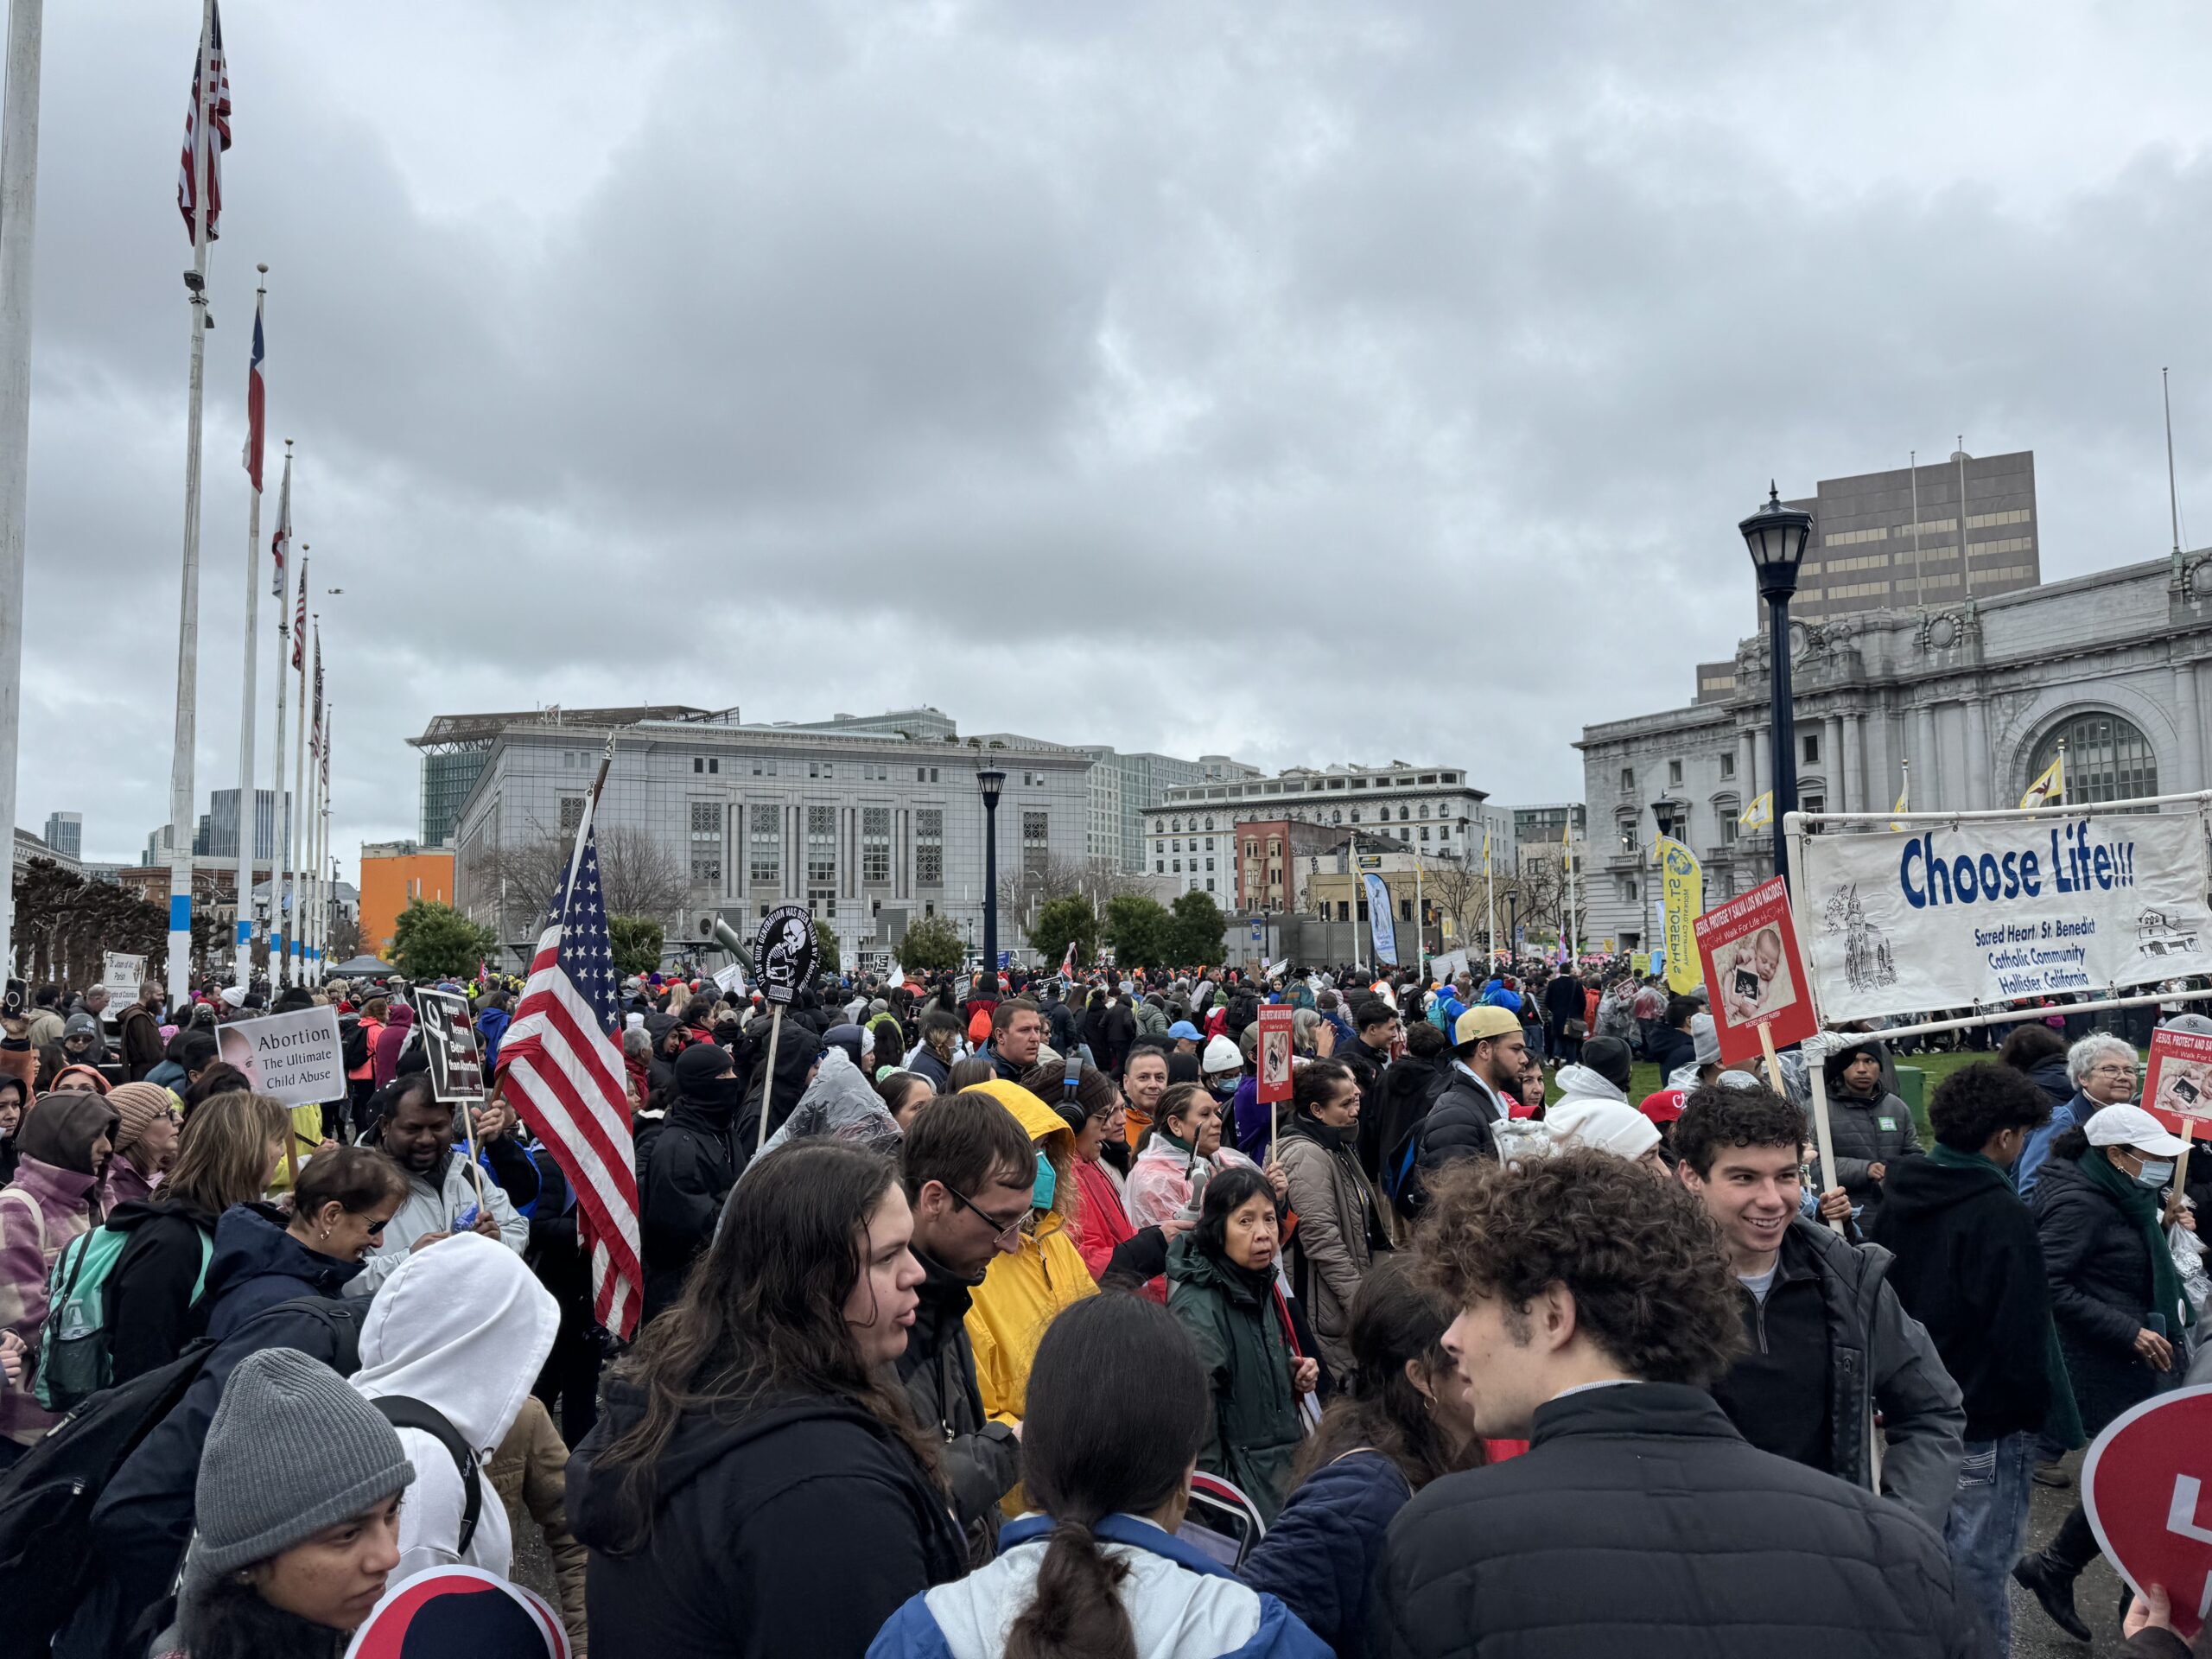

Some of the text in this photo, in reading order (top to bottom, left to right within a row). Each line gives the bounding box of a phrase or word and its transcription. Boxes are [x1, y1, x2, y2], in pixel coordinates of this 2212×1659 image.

[1901, 821, 2134, 909] Choose Life!!!
[1727, 906, 1732, 921] Y
[1732, 899, 1746, 919] SALVA
[1745, 895, 1756, 912] LOS
[1754, 892, 1763, 907] NO
[1761, 881, 1783, 904] NACIDOS
[785, 907, 798, 917] HAS
[798, 909, 810, 925] BEEN
[759, 907, 785, 944] GENERATION
[807, 921, 817, 946] KILLED
[1724, 918, 1760, 940] Walk For Life
[1974, 924, 2005, 947] Sacred
[2041, 921, 2053, 939] St.
[2056, 916, 2095, 938] Benedict
[754, 945, 763, 961] OUR
[811, 947, 818, 957] BY
[1988, 944, 2085, 970] Catholic Community
[754, 963, 763, 974] OF
[797, 959, 817, 994] ABORTION
[2044, 969, 2088, 989] California
[451, 1021, 469, 1036] Deserve
[258, 1027, 331, 1052] Abortion
[449, 1040, 466, 1054] Better
[2156, 1033, 2171, 1046] JESUS,
[2172, 1035, 2195, 1048] PROTECT
[2194, 1038, 2205, 1050] AND
[263, 1050, 332, 1070] The Ultimate
[266, 1070, 331, 1089] Child Abuse
